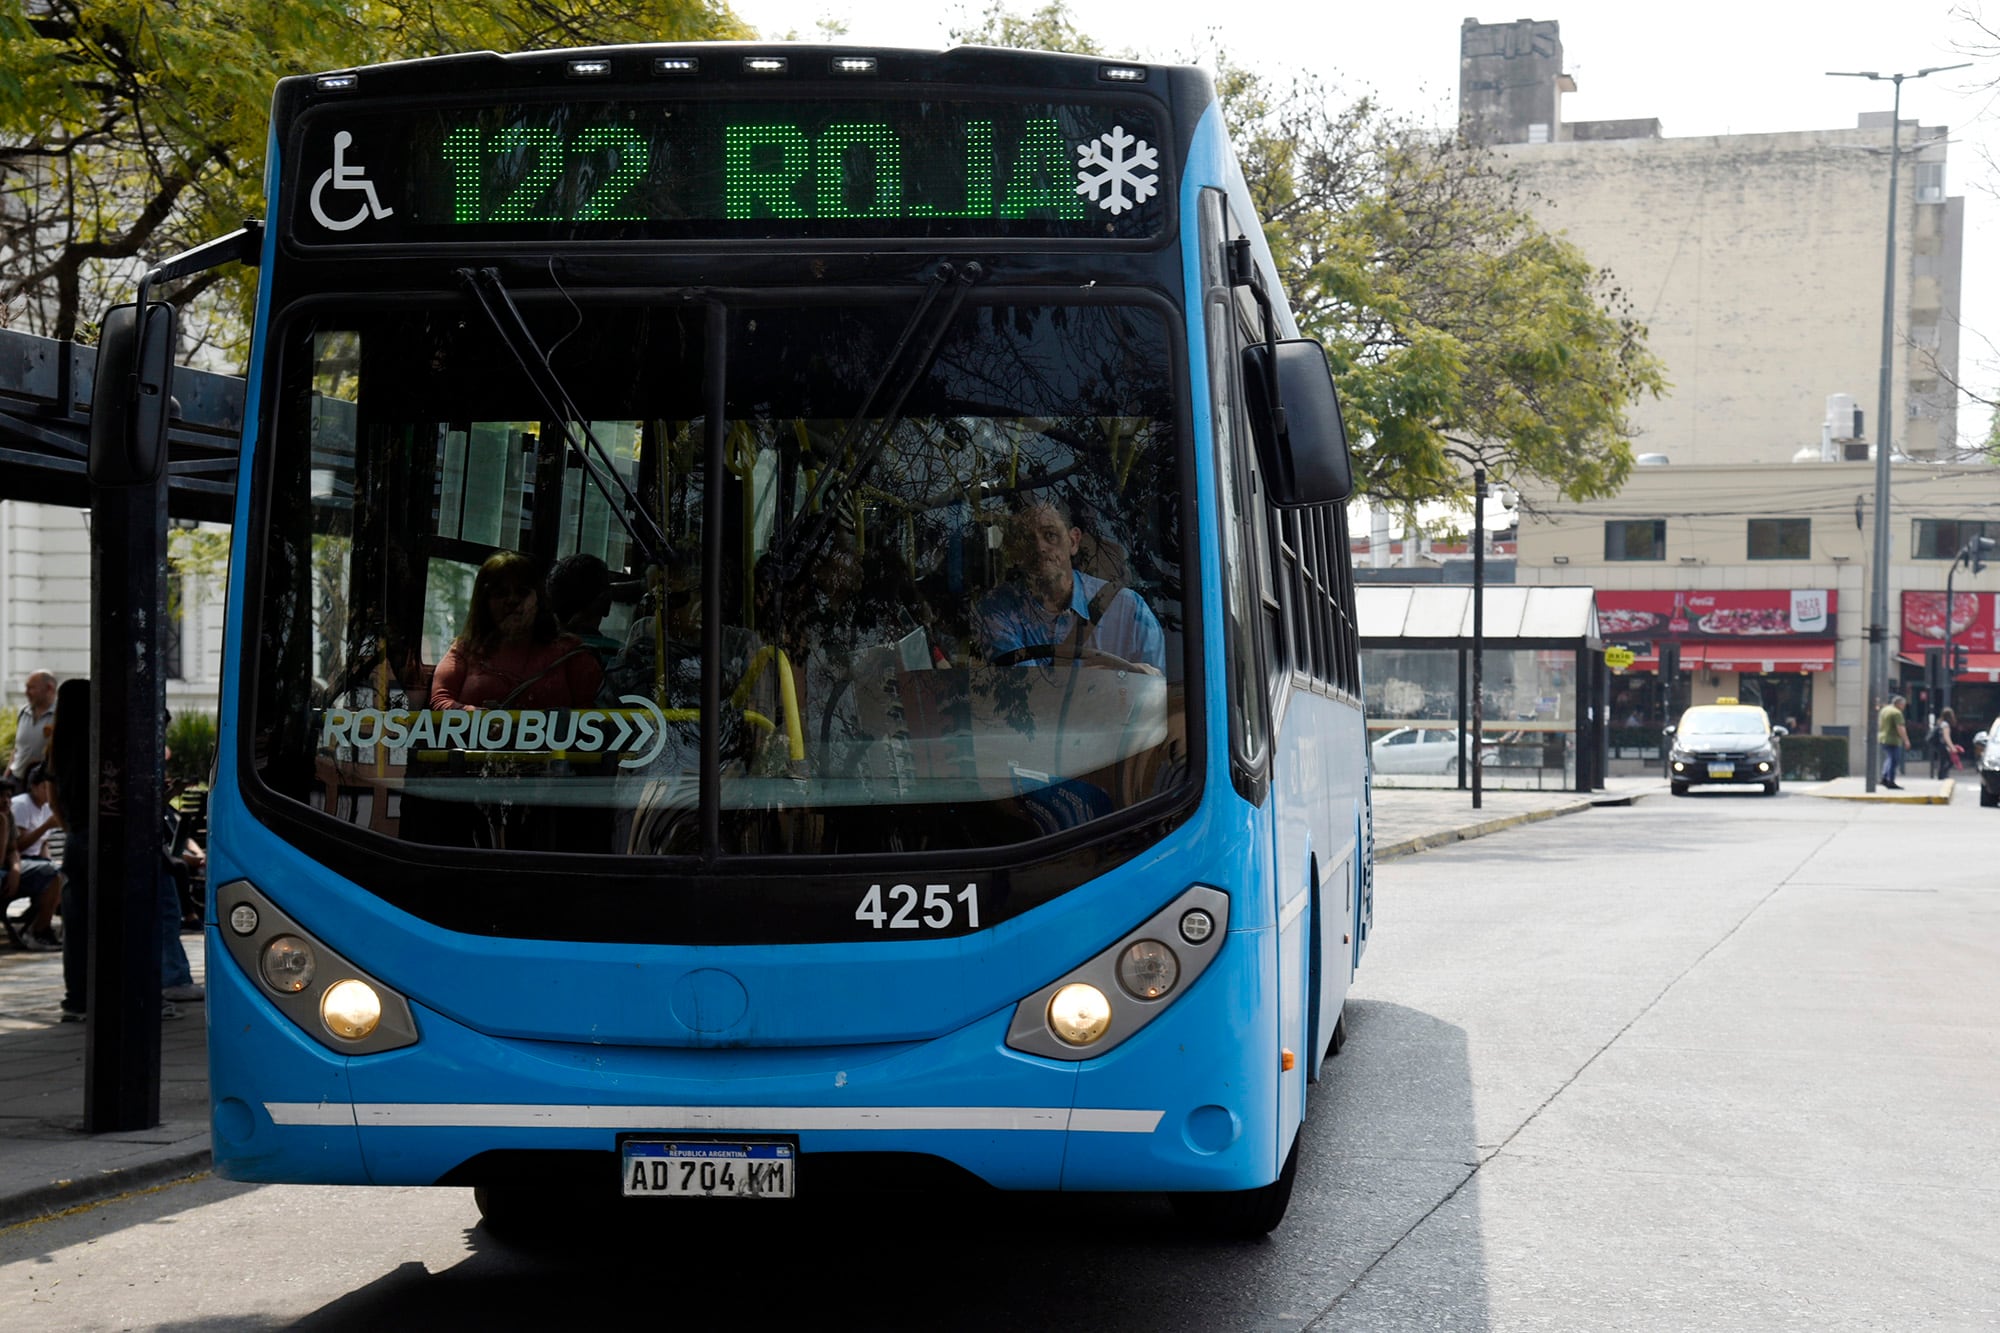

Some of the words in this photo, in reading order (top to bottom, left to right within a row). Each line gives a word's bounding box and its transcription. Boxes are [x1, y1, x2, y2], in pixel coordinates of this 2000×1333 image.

[443, 127, 648, 222] 122
[726, 118, 1085, 220] ROJA
[855, 883, 979, 929] 4251
[708, 1151, 747, 1159] ARGENTINA
[631, 1161, 668, 1191] AD
[680, 1161, 735, 1192] 704
[747, 1162, 785, 1193] KM
